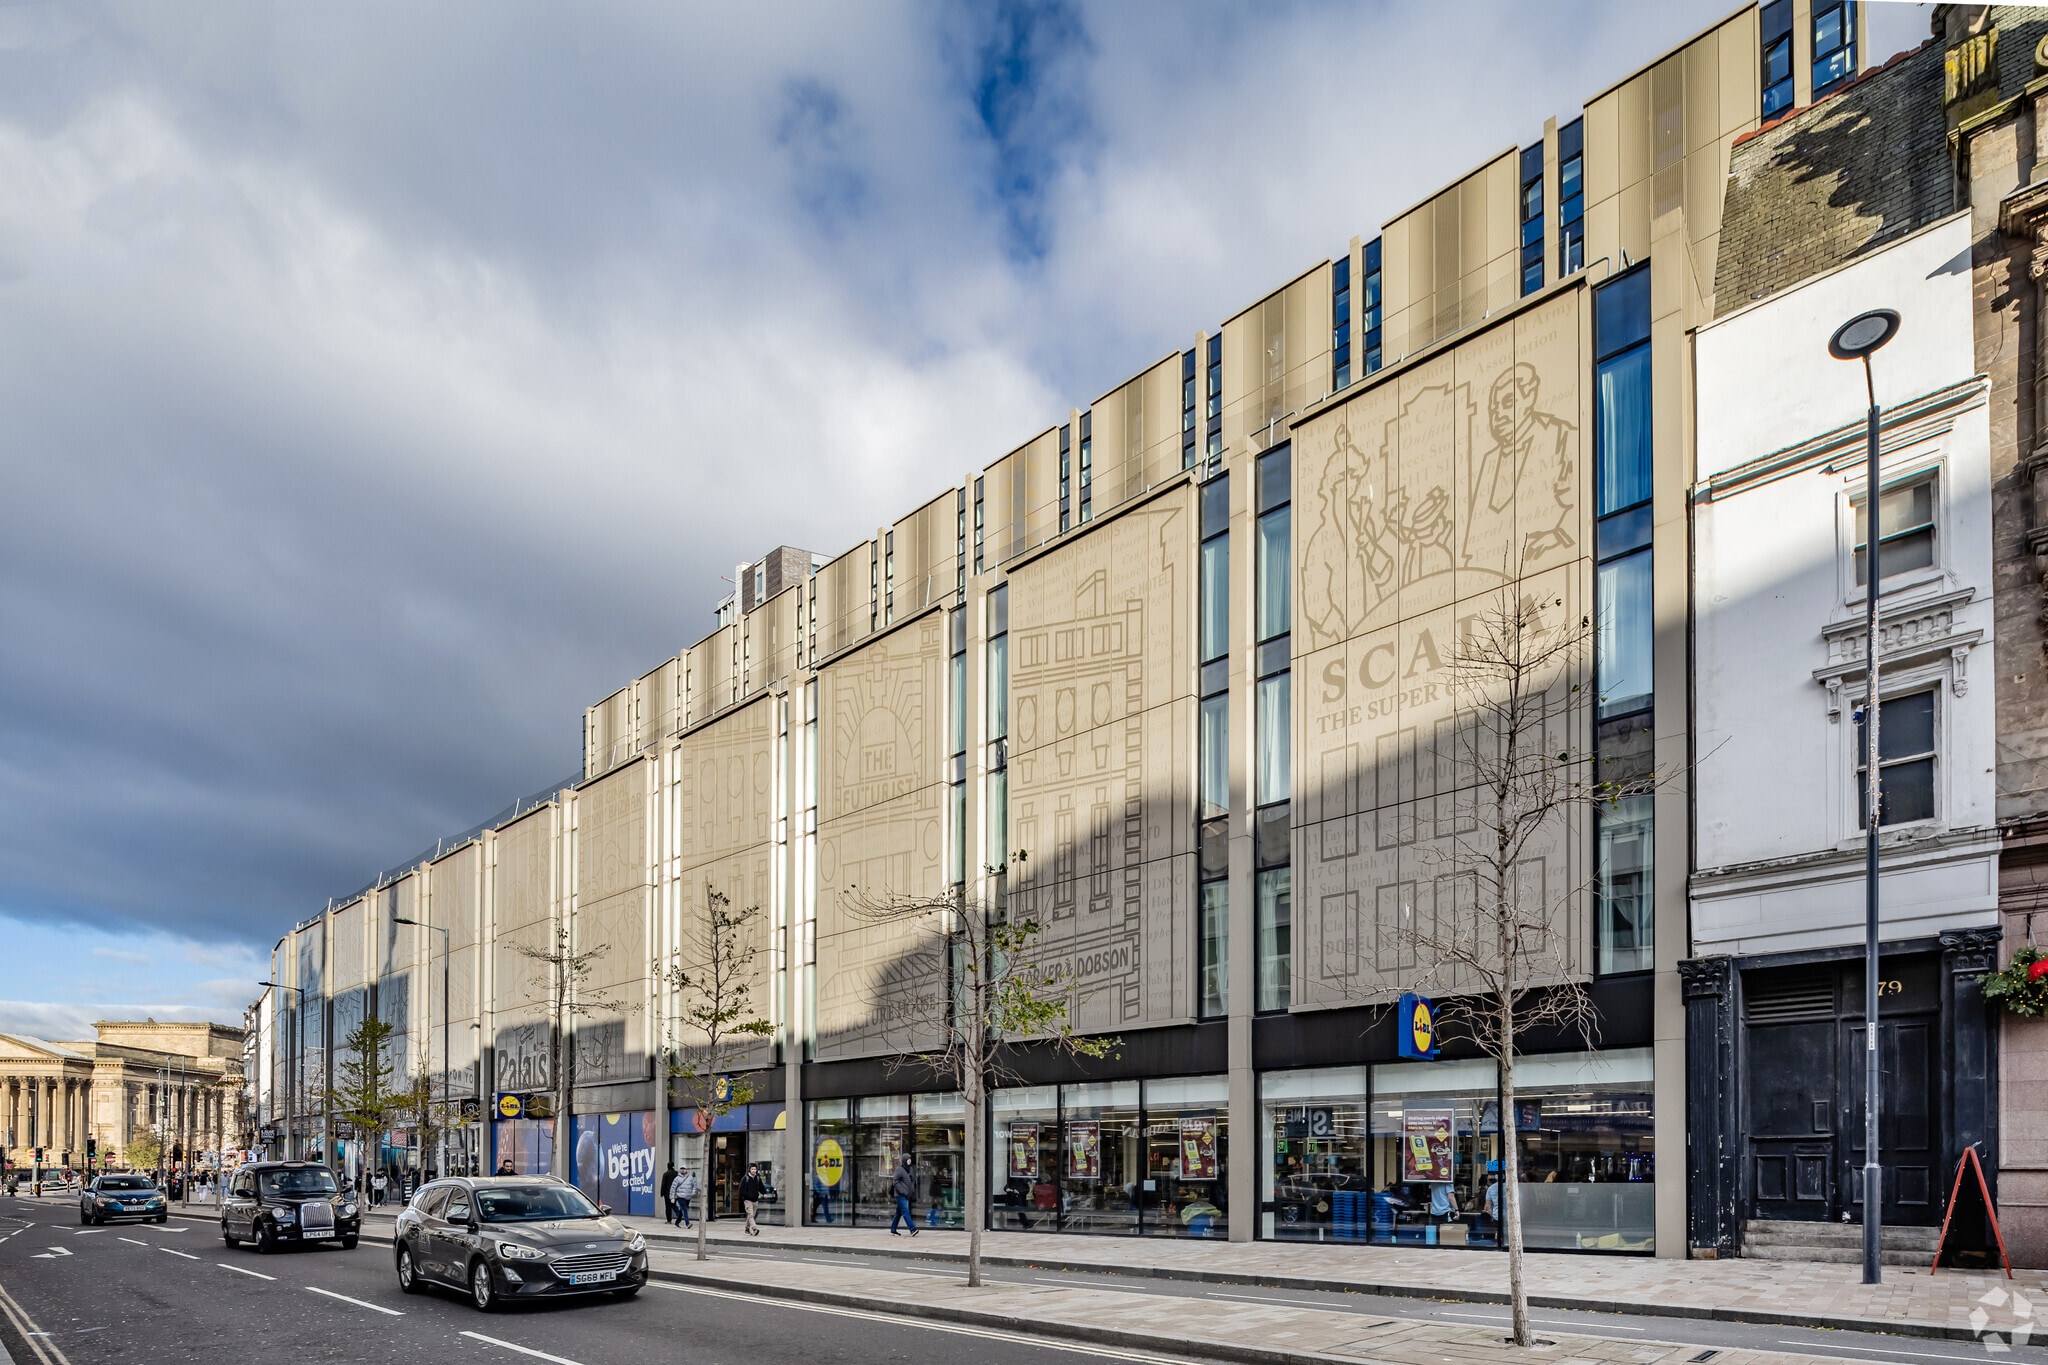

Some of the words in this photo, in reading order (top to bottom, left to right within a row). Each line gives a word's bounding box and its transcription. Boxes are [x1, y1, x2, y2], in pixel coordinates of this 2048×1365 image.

[1316, 704, 1362, 734] THE
[1367, 681, 1439, 721] SUPER
[864, 748, 893, 773] THE
[843, 778, 913, 811] FUTURIST
[1065, 958, 1073, 977] &
[1077, 947, 1128, 978] DOBSON
[1878, 980, 1902, 996] 79
[498, 1045, 547, 1091] Palais
[612, 1143, 628, 1154] We're
[608, 1147, 655, 1180] berry
[622, 1174, 645, 1188] excited
[576, 1274, 598, 1282] SG68
[600, 1272, 614, 1280] WFL
